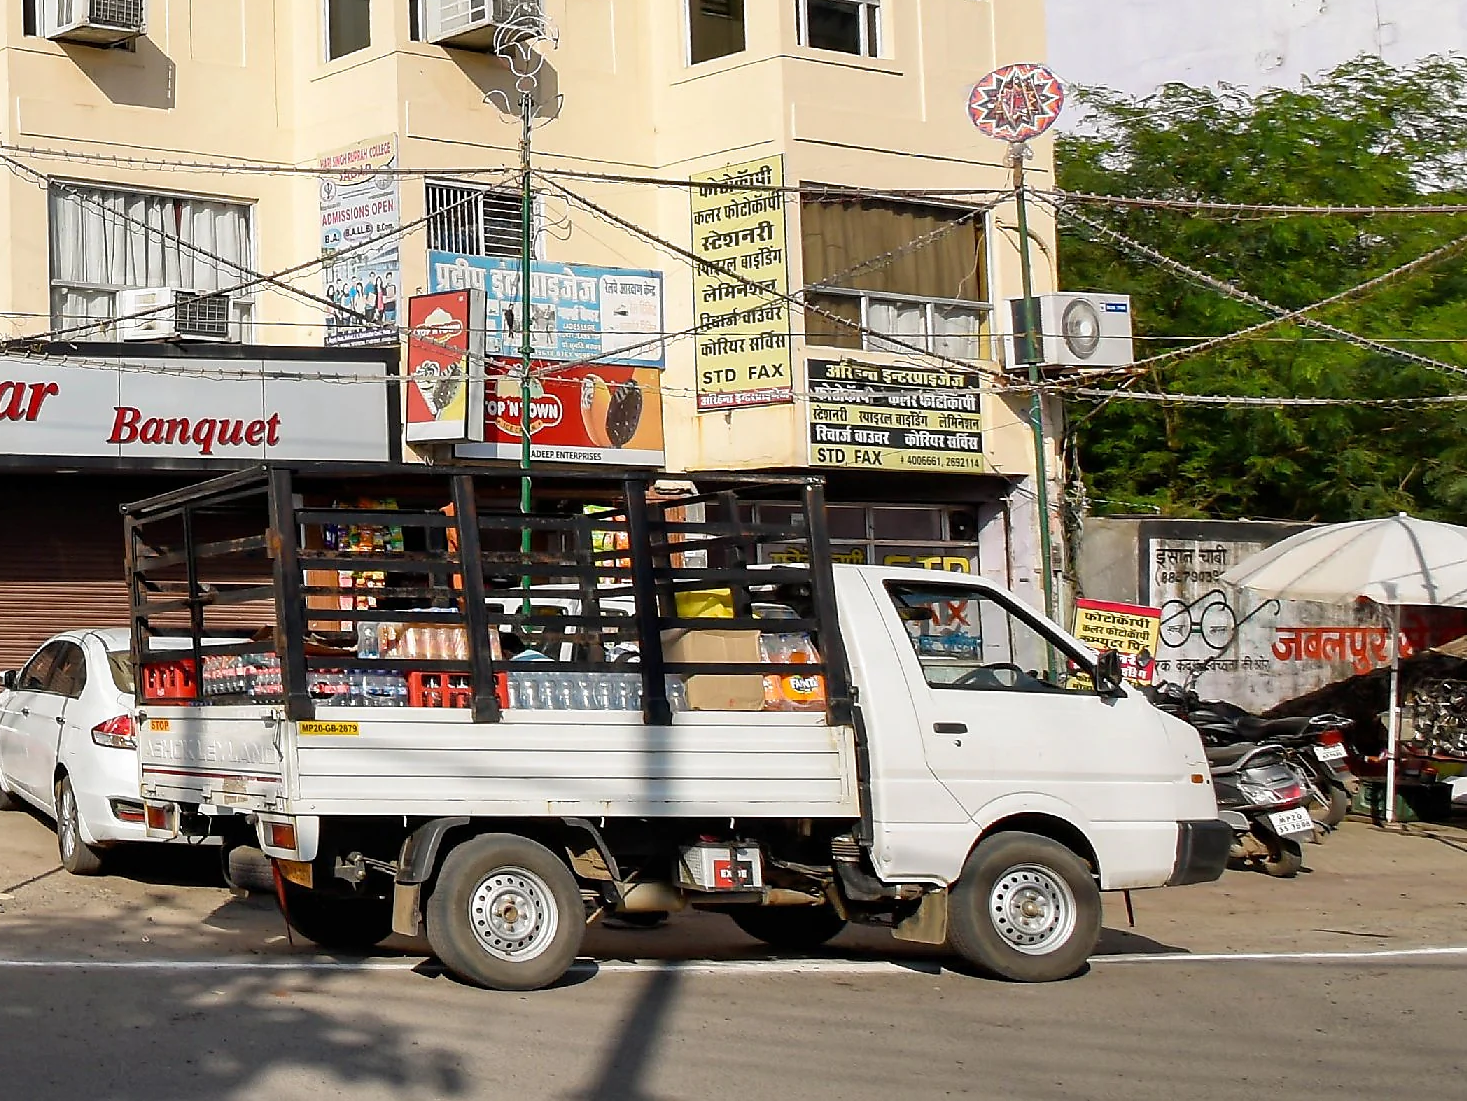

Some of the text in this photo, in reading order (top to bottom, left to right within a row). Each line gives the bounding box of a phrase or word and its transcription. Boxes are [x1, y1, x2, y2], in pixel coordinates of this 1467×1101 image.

[369, 142, 390, 158] COLLEGE
[322, 199, 394, 226] ADMISSIONS OPEN
[693, 207, 721, 225] कलर
[701, 221, 775, 250] स्टेशनरी
[436, 258, 486, 291] प्रदीप
[700, 330, 785, 356] कोरियर सर्विस
[703, 363, 783, 384] STD FAX
[106, 406, 281, 455] Banquet
[904, 431, 945, 448] कोरियर
[947, 432, 979, 449] सर्विस
[556, 451, 602, 461] ENTERPRISES
[817, 448, 845, 463] STD
[854, 449, 882, 465] FAX
[1082, 624, 1104, 634] कलर
[1272, 628, 1390, 675] जबलपुर
[151, 720, 169, 731] STOP
[301, 724, 358, 734] MP20-GB-2879
[720, 869, 748, 879] EXDE
